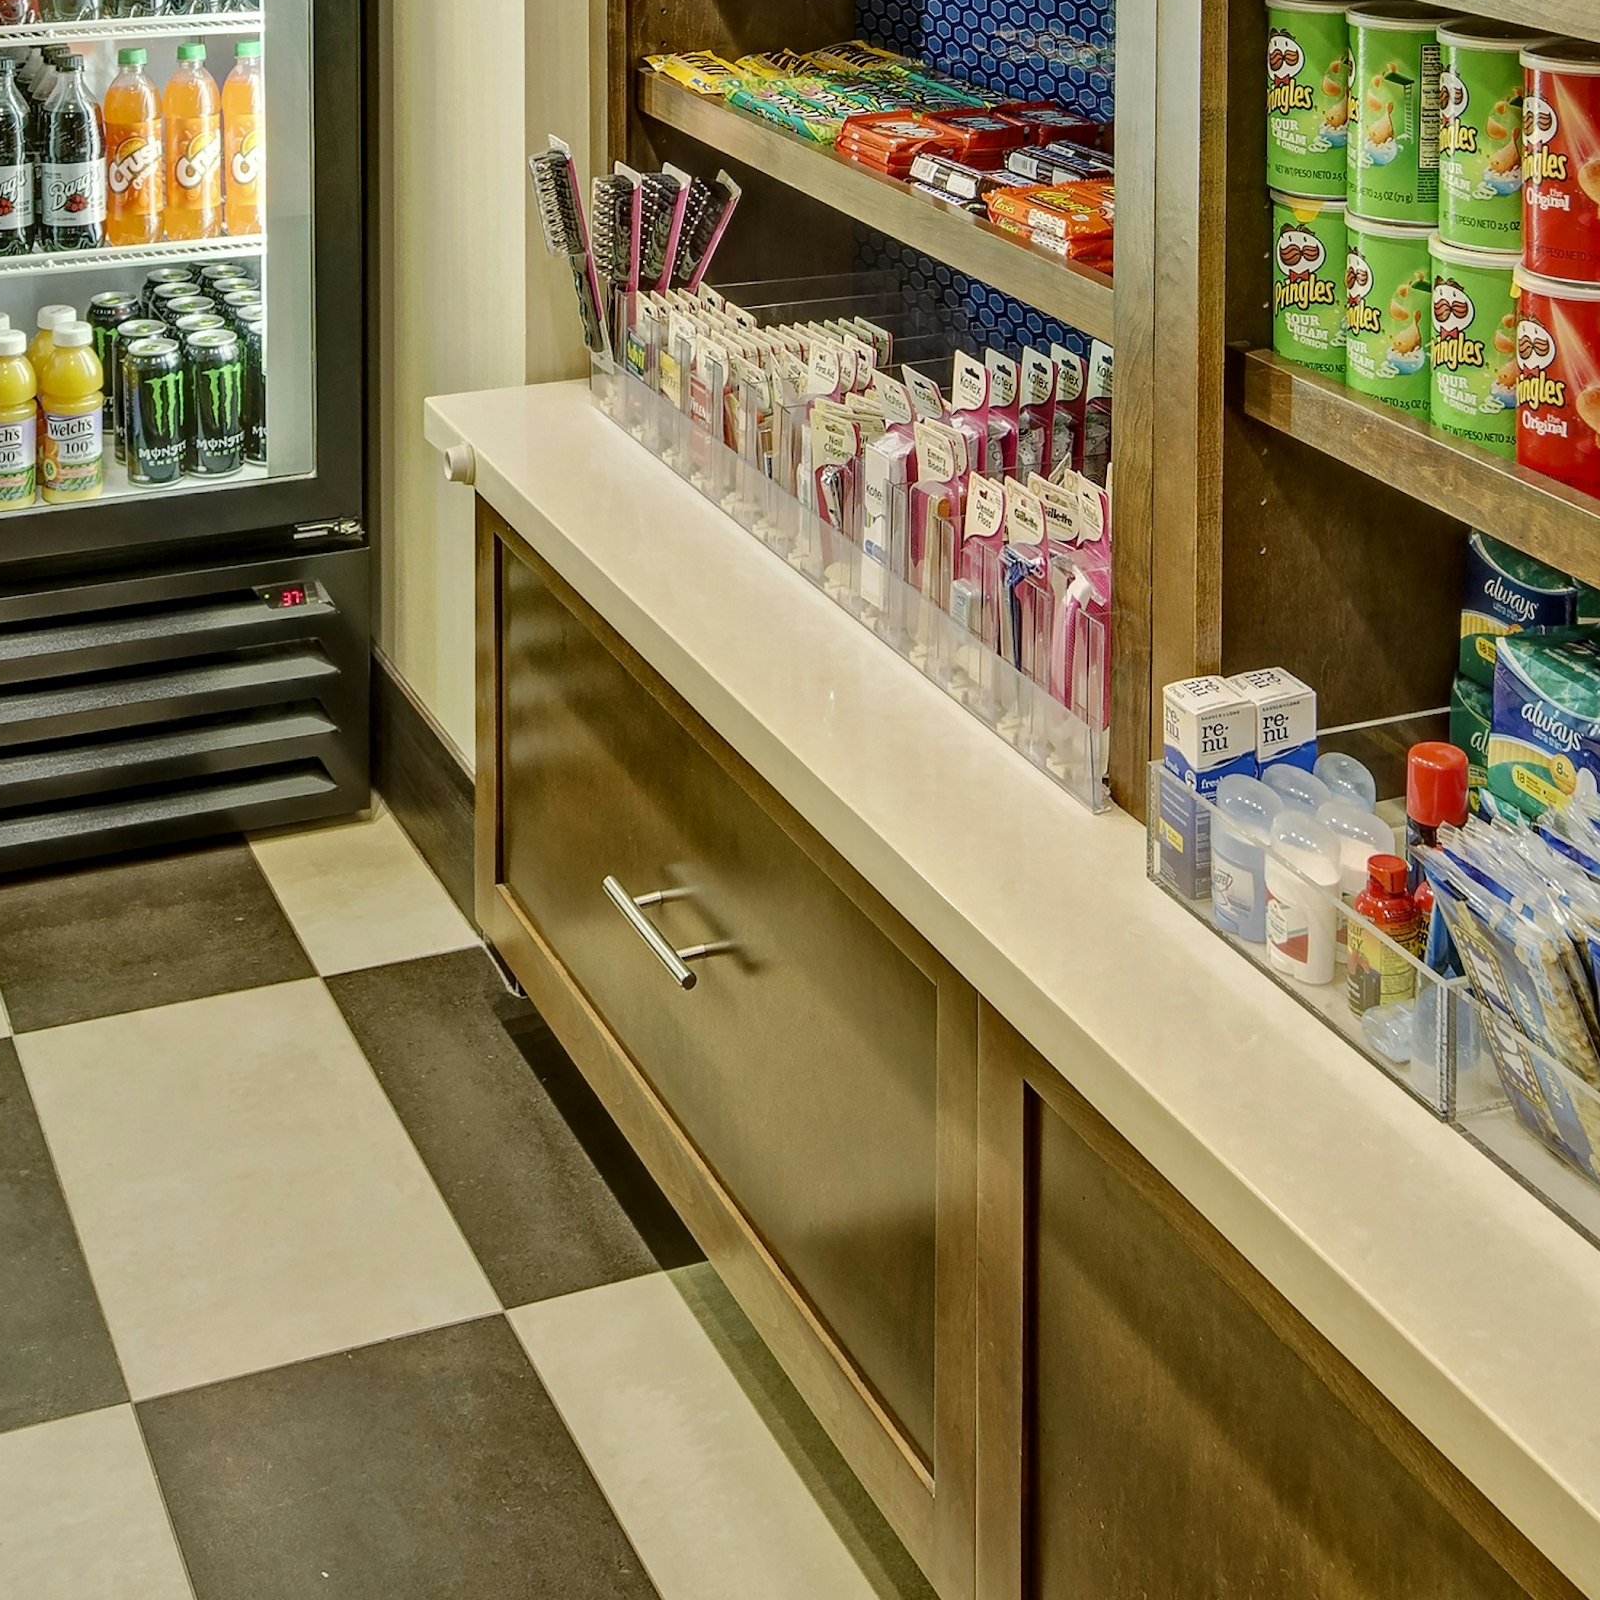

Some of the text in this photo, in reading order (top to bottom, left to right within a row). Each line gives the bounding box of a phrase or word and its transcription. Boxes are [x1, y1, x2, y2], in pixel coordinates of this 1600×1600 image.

[1270, 116, 1300, 132] SOUR
[1271, 128, 1308, 145] CREAM
[1274, 273, 1336, 315] Pringles
[1284, 311, 1321, 326] SOUR
[1286, 323, 1329, 341] CREAM
[959, 374, 983, 397] kotex
[48, 418, 93, 439] Welch's
[1521, 412, 1568, 439] Original
[828, 435, 843, 447] Nail
[927, 449, 947, 466] Emery
[927, 458, 950, 477] Boards
[976, 500, 996, 518] Dental
[977, 511, 992, 528] Floss
[1014, 508, 1039, 530] Gillette
[1484, 576, 1538, 621] always
[1521, 700, 1584, 753] always
[1202, 737, 1229, 753] nu
[1263, 728, 1289, 744] nu
